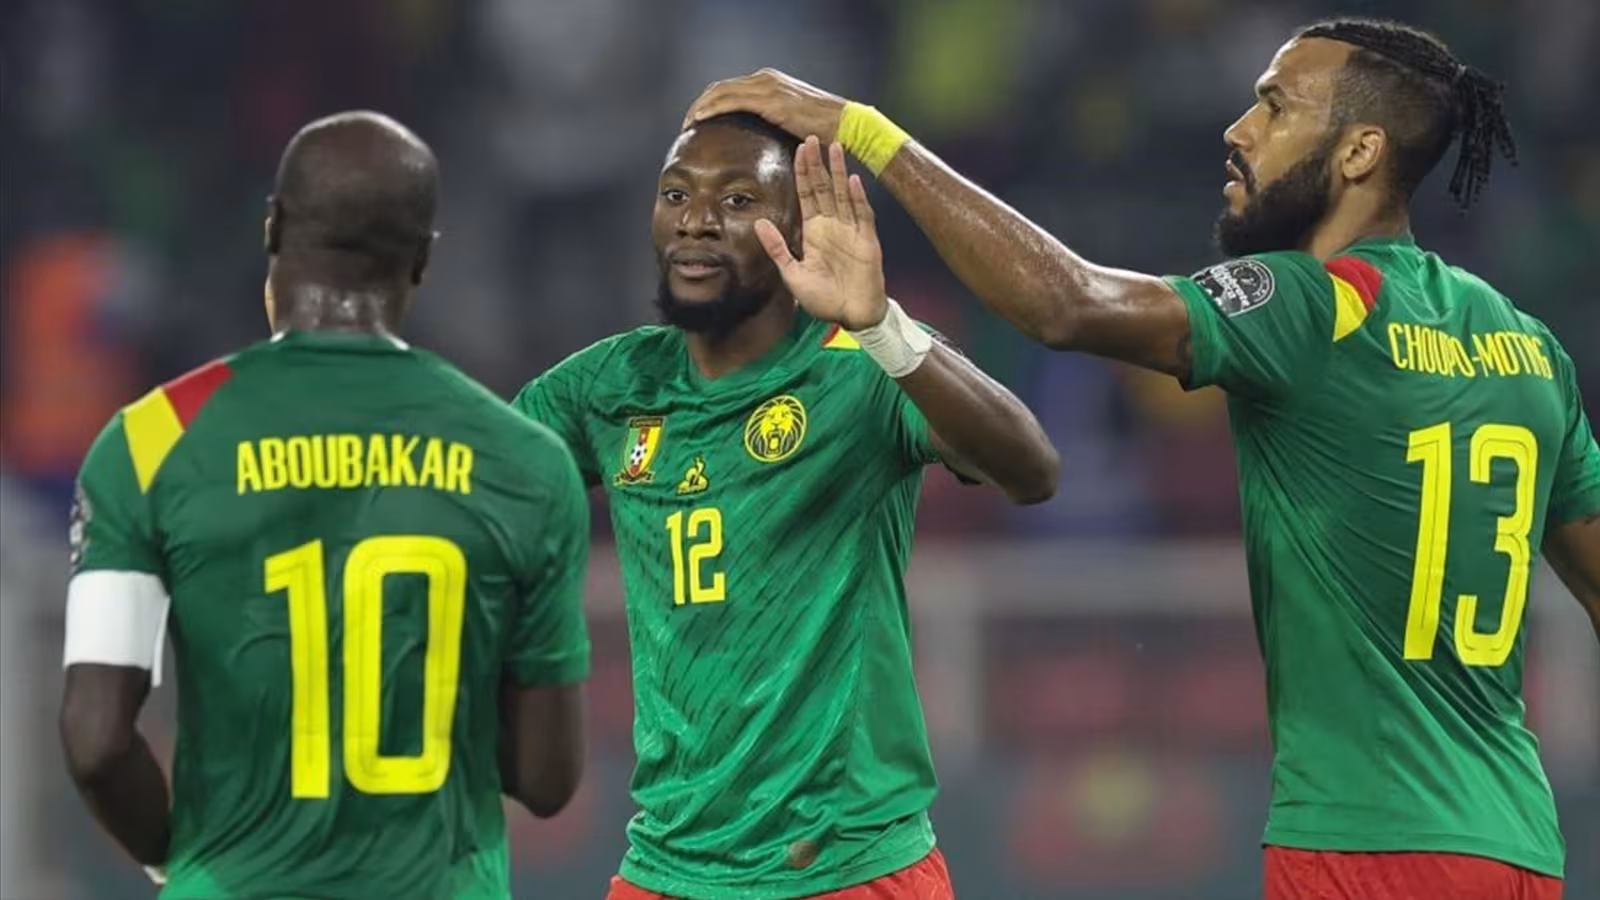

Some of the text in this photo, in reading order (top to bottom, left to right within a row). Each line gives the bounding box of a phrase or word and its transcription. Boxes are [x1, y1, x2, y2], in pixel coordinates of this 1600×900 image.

[237, 433, 473, 496] ABOUBAKAR
[1403, 422, 1539, 668] 13
[666, 508, 726, 605] 12
[263, 534, 467, 800] 10
